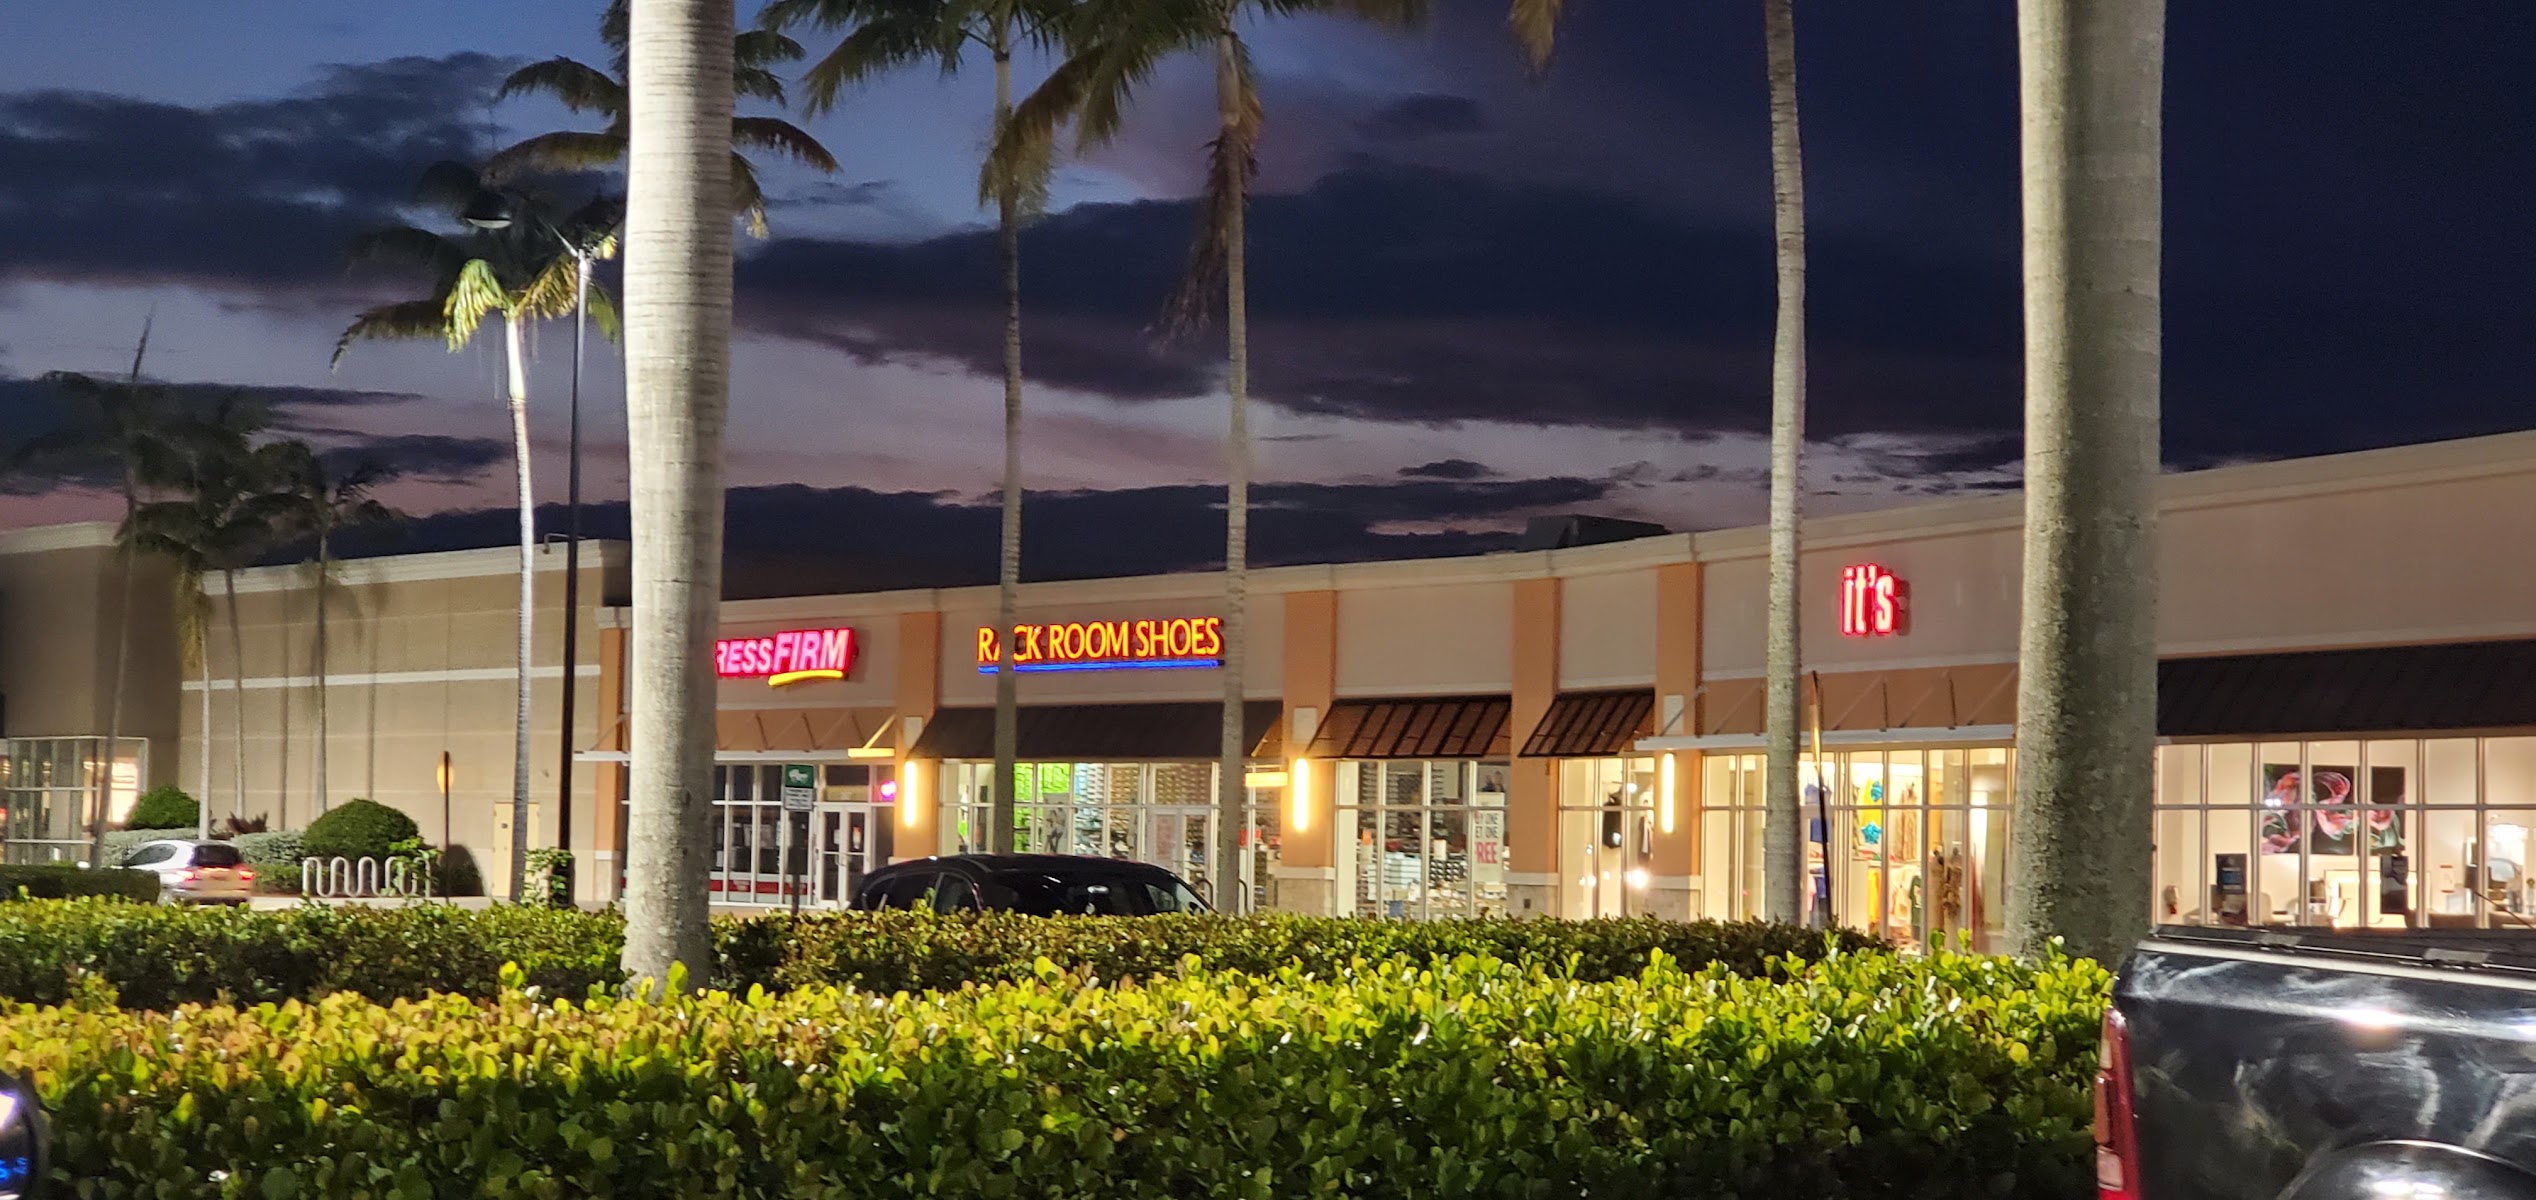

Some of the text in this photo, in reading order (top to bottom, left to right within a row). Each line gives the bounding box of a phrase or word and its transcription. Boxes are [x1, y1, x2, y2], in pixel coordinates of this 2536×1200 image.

[1842, 563, 1895, 636] it's
[978, 617, 1221, 662] RCK ROOM SHOES
